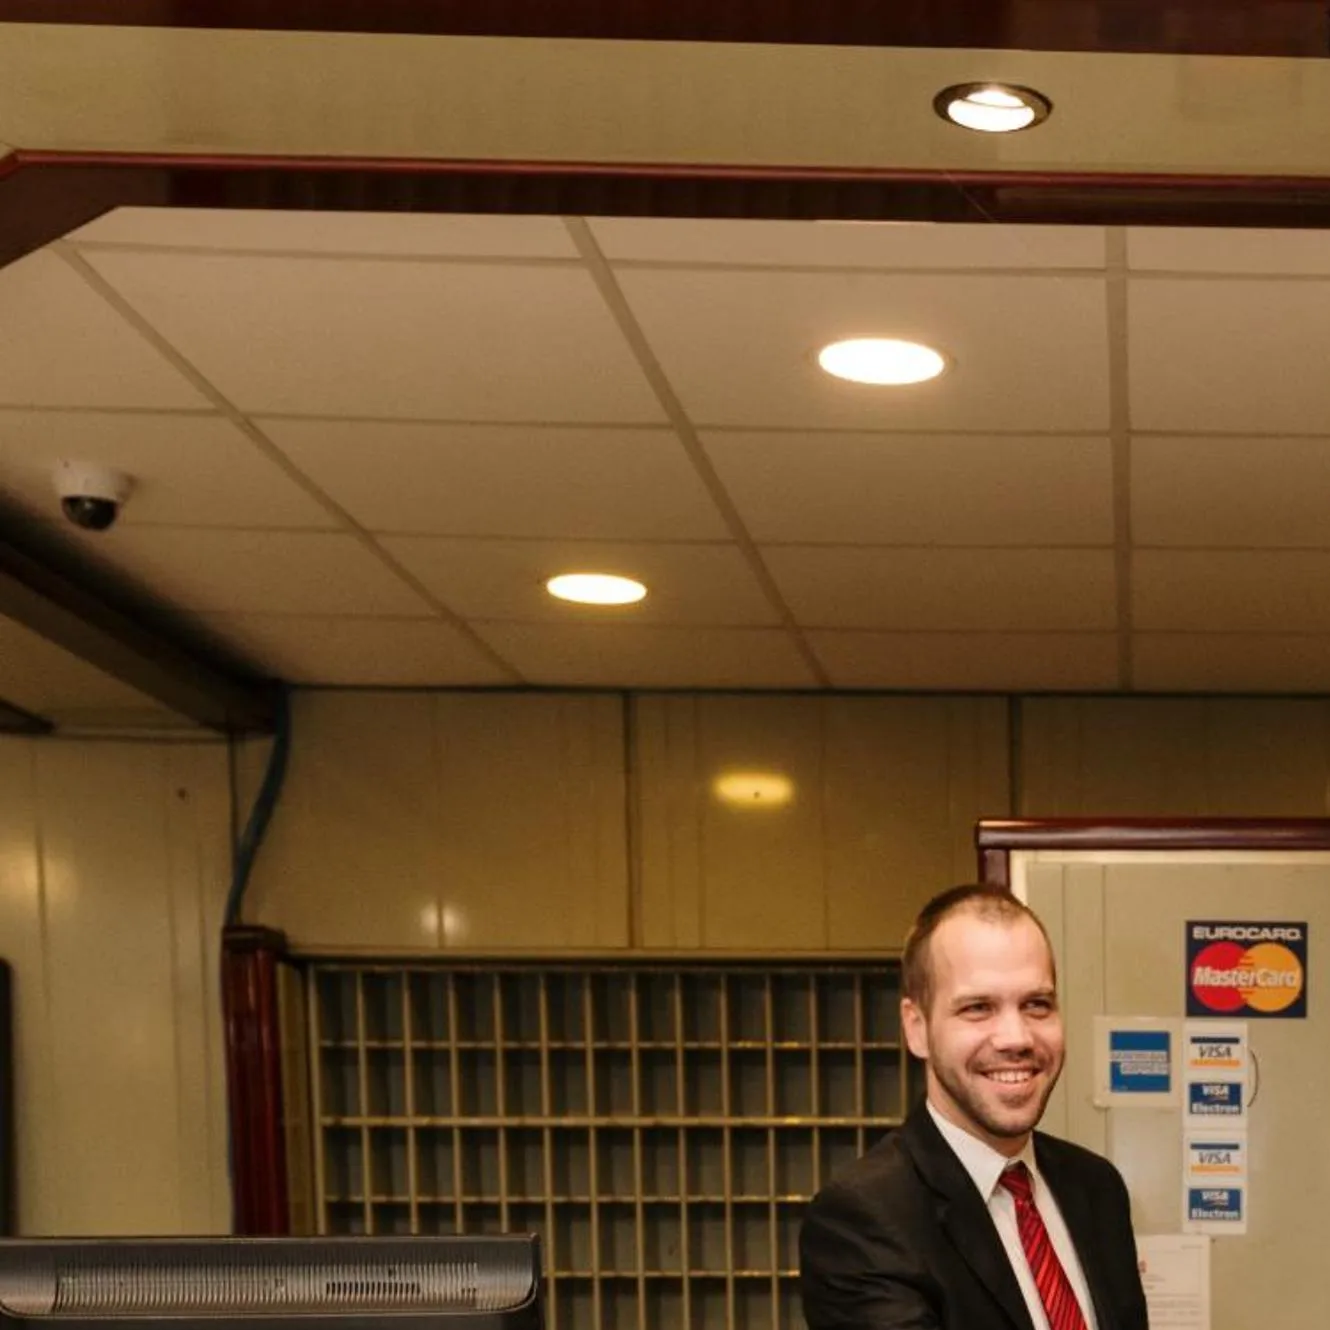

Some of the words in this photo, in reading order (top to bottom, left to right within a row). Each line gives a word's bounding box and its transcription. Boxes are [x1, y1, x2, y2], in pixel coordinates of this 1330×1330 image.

[1192, 926, 1302, 940] EUROCARD
[1192, 965, 1299, 987] MasterCard
[1199, 1045, 1233, 1058] VISA
[1202, 1085, 1229, 1096] VISA
[1199, 1151, 1232, 1165] VISA
